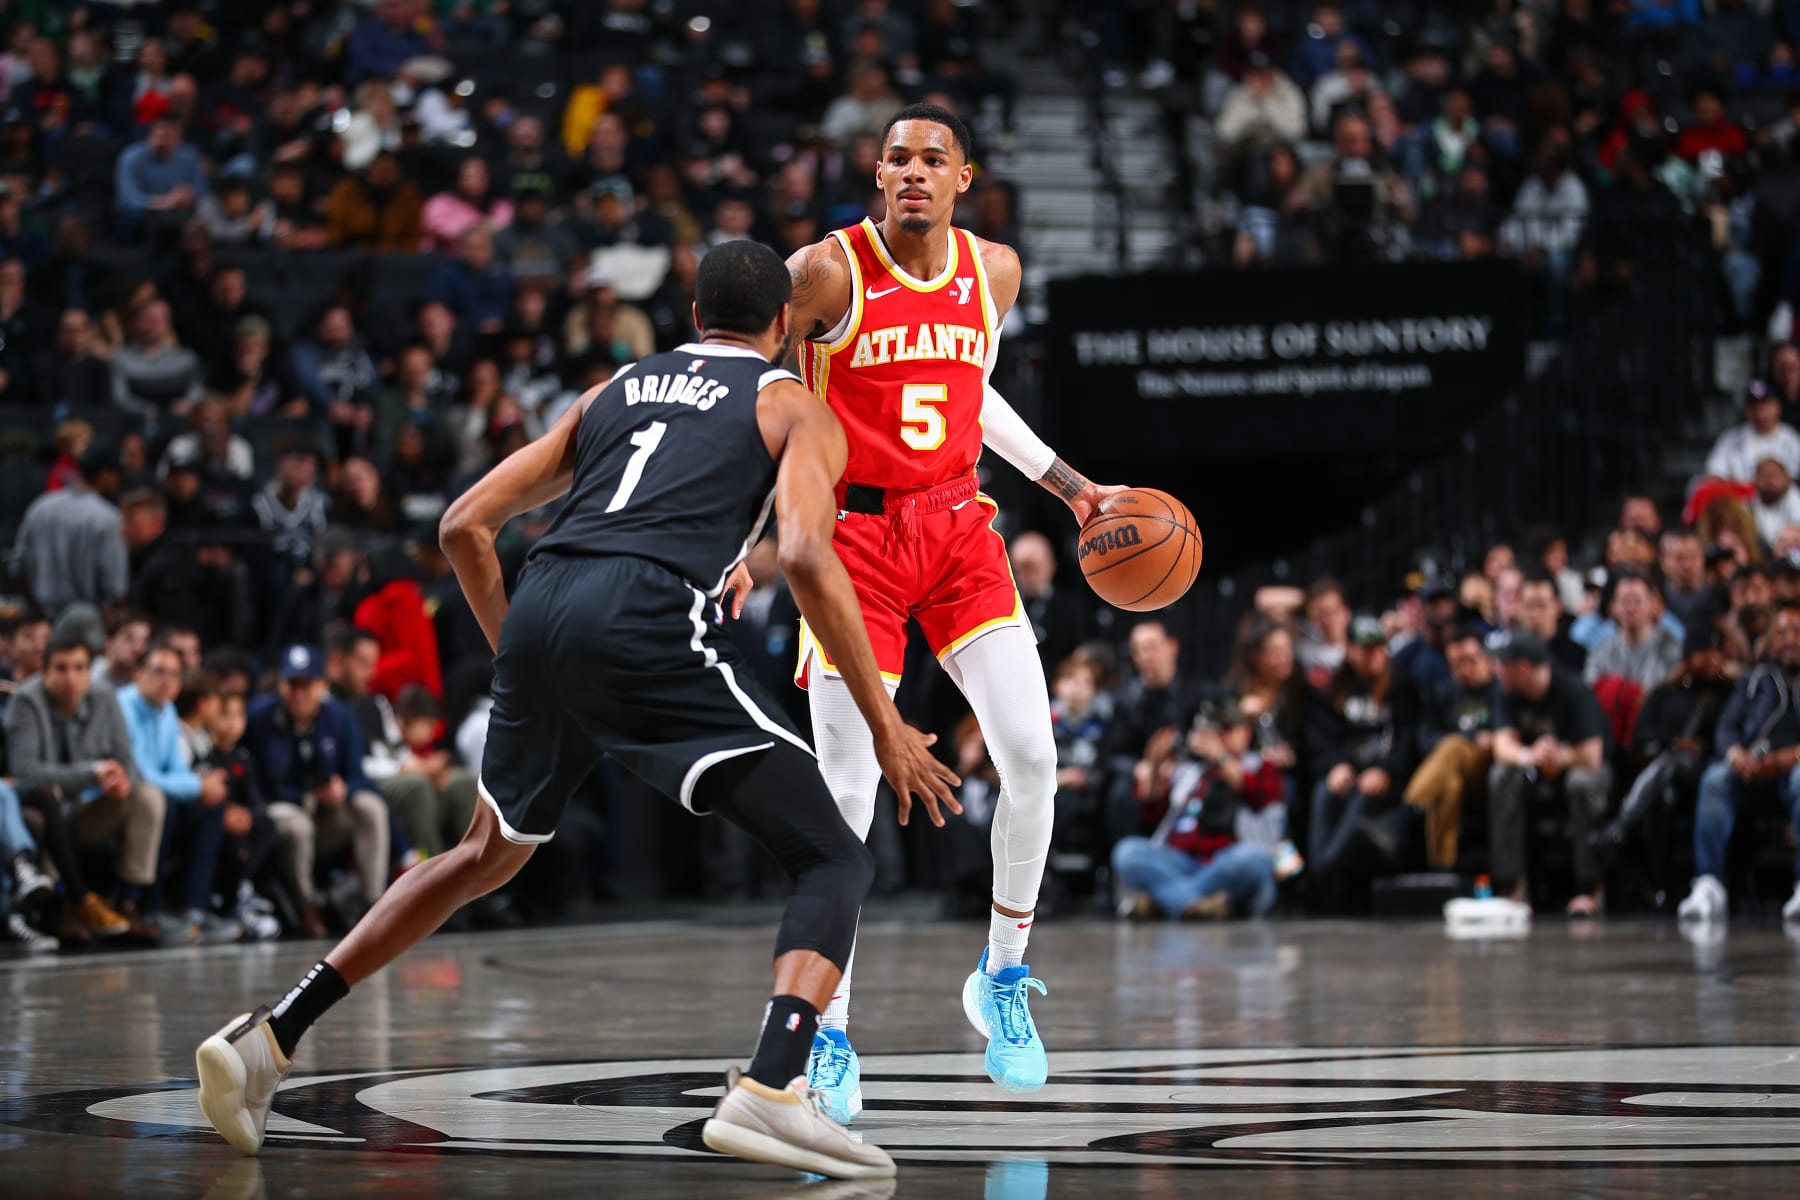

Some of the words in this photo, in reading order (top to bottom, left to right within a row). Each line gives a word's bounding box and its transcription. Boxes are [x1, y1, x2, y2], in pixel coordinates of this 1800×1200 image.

[850, 323, 985, 369] ATLANTA
[1074, 330, 1139, 366] THE
[1146, 325, 1265, 363] HOUSE
[1270, 321, 1317, 360] OF
[1323, 314, 1491, 356] SUNTORY
[624, 374, 729, 412] BRIDGES
[900, 383, 948, 450] 5
[604, 420, 668, 513] 1
[1079, 523, 1143, 561] Wilson
